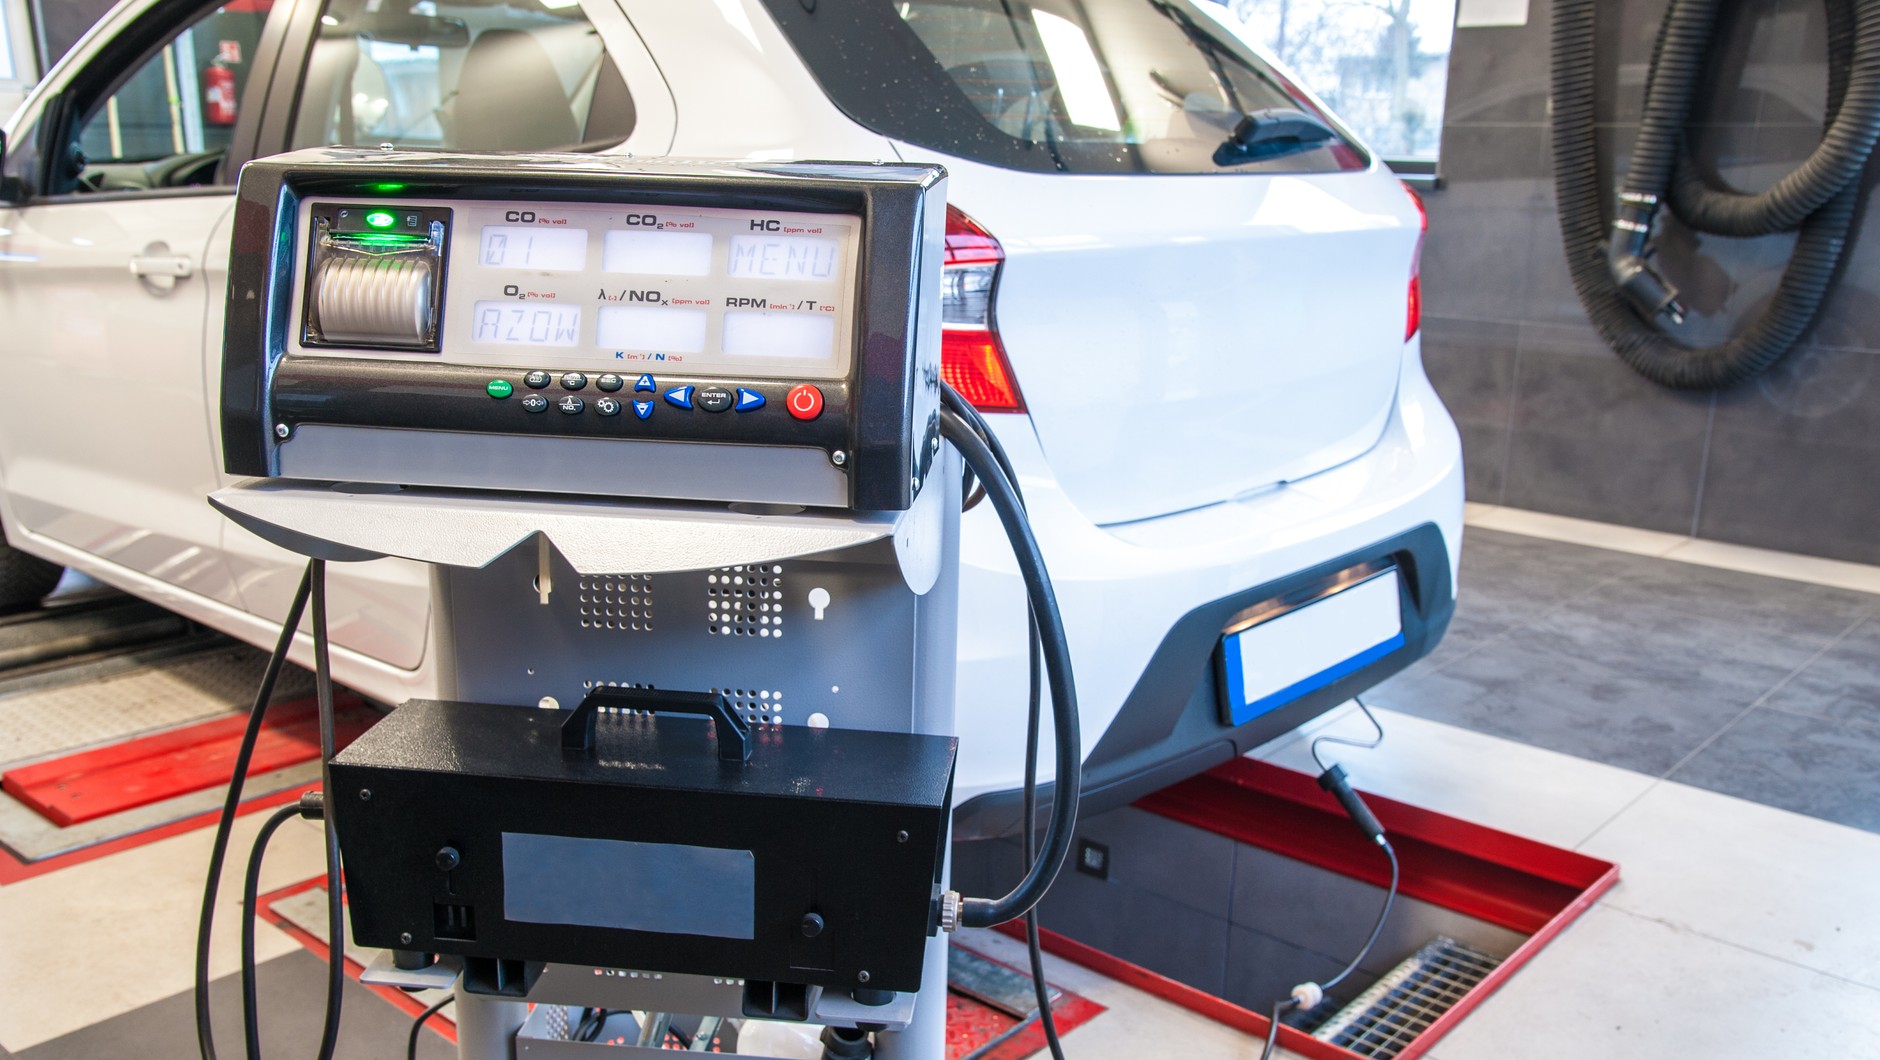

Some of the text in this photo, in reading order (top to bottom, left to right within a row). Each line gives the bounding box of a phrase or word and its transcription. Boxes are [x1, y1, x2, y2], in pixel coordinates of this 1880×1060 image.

[505, 211, 536, 223] CO
[750, 219, 780, 232] HC
[733, 243, 834, 277] MENU
[726, 297, 767, 308] RPM
[806, 300, 817, 310] T
[478, 308, 578, 342] AZOW
[615, 352, 624, 360] K
[655, 353, 666, 361] N
